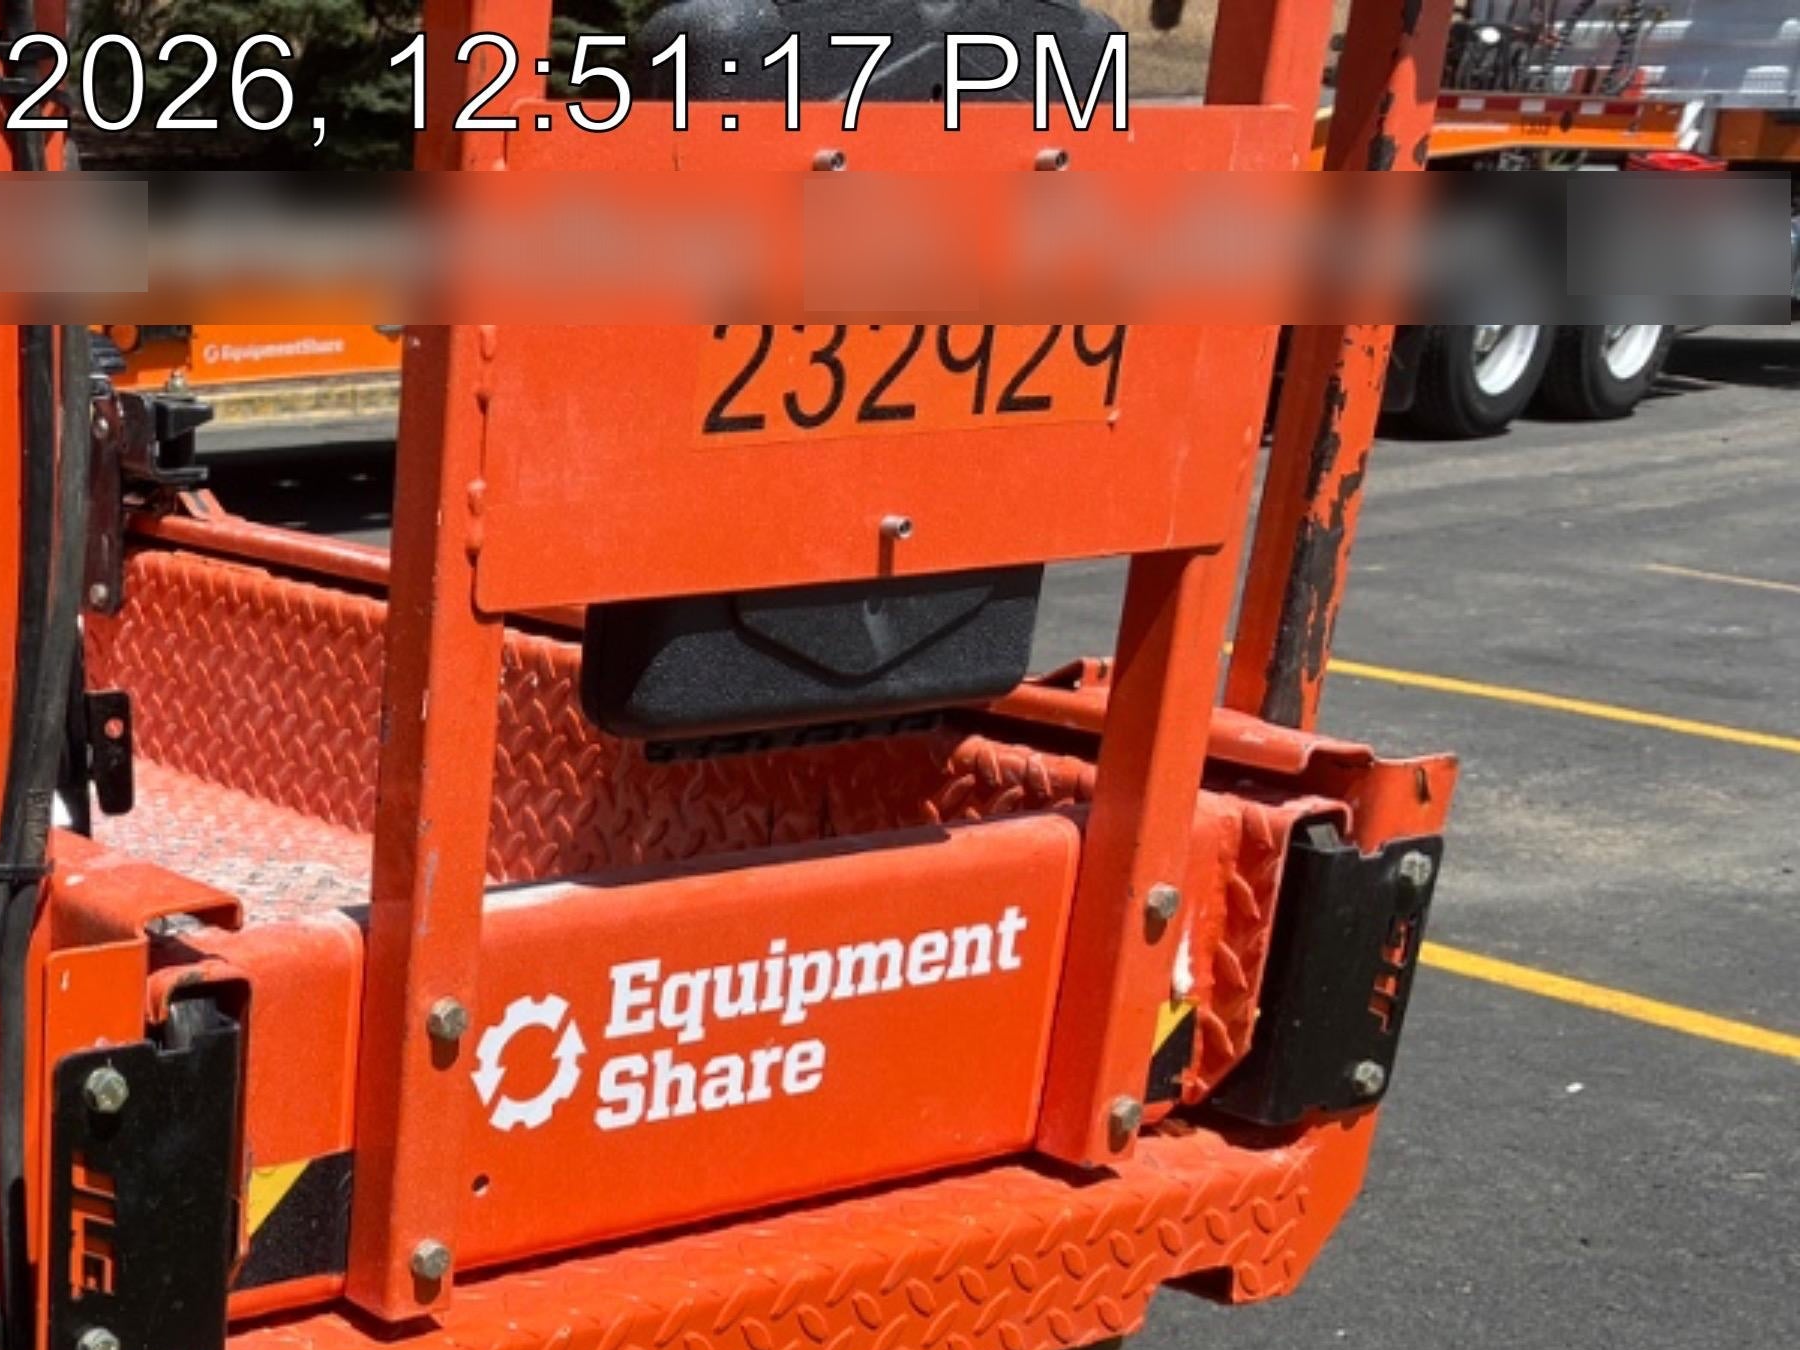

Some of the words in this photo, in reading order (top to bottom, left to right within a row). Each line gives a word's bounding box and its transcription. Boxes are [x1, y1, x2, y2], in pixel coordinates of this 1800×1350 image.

[702, 323, 1127, 436] 232929
[603, 904, 1028, 1046] Equipment
[594, 1037, 827, 1132] Share
[68, 1150, 119, 1303] JLG
